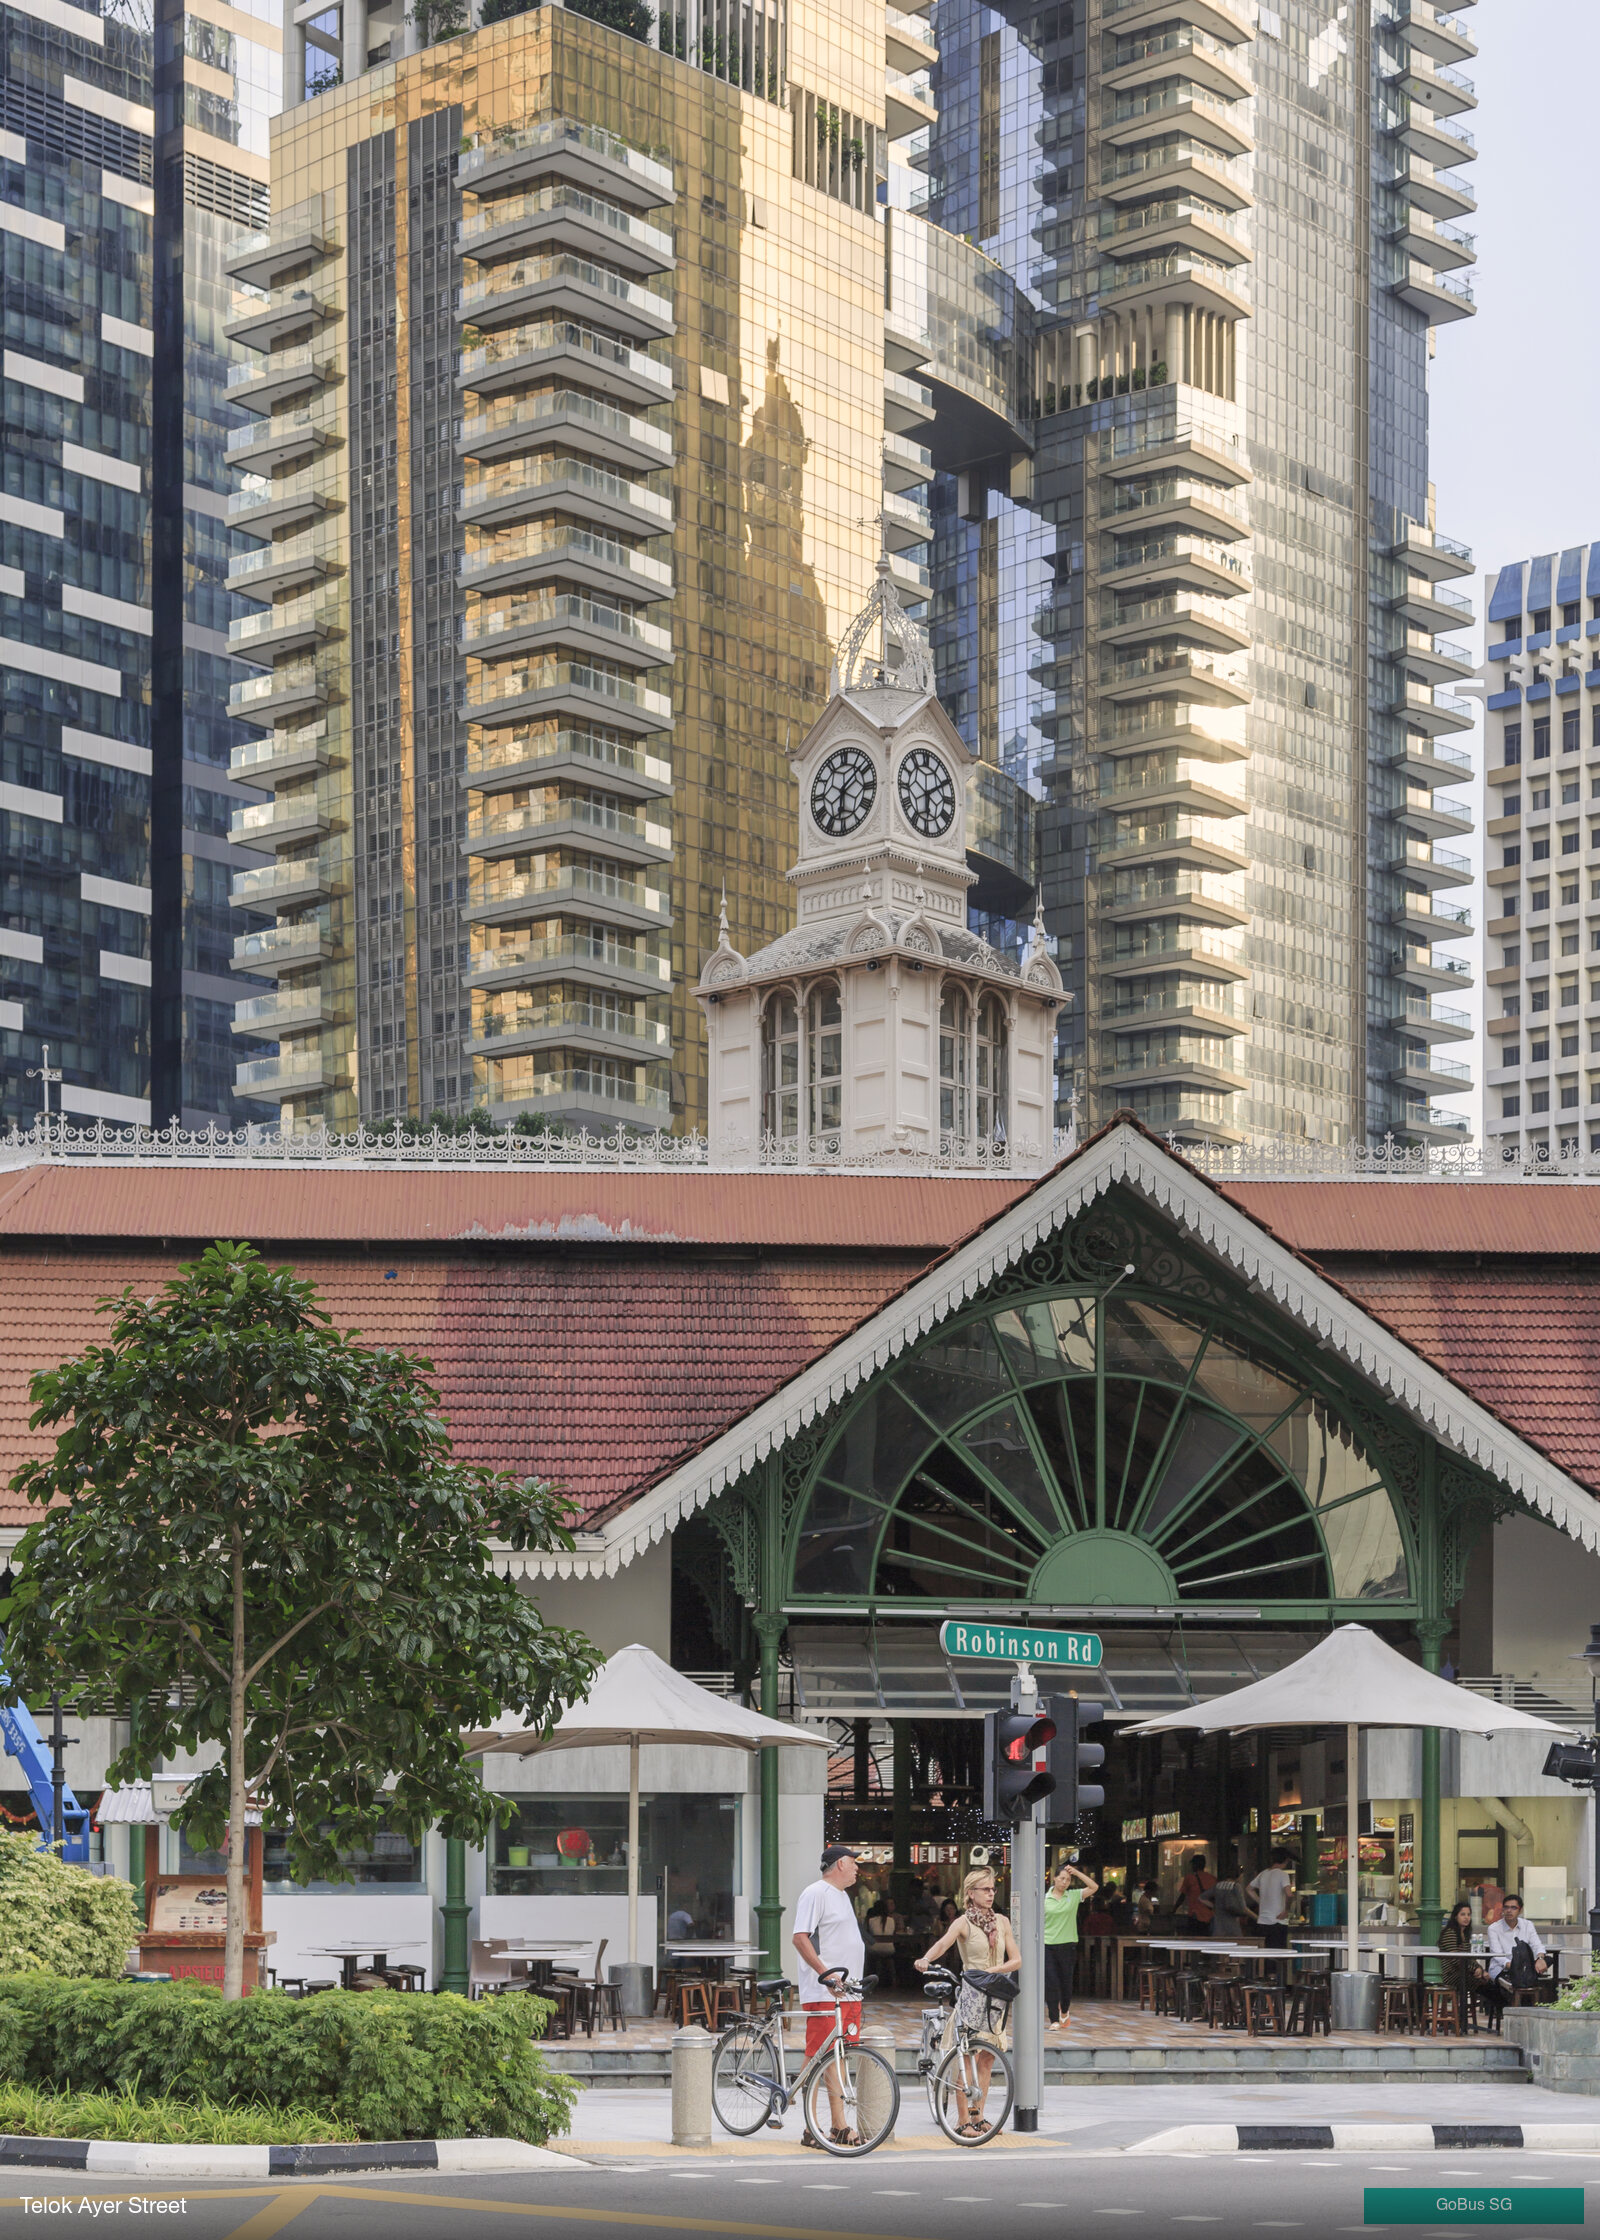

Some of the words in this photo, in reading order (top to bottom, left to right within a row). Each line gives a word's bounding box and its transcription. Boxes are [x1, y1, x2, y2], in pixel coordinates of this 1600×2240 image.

[956, 1627, 1058, 1660] Robinson
[1068, 1636, 1092, 1662] Rd
[169, 1965, 176, 1980] A
[178, 1965, 212, 1980] TASTE
